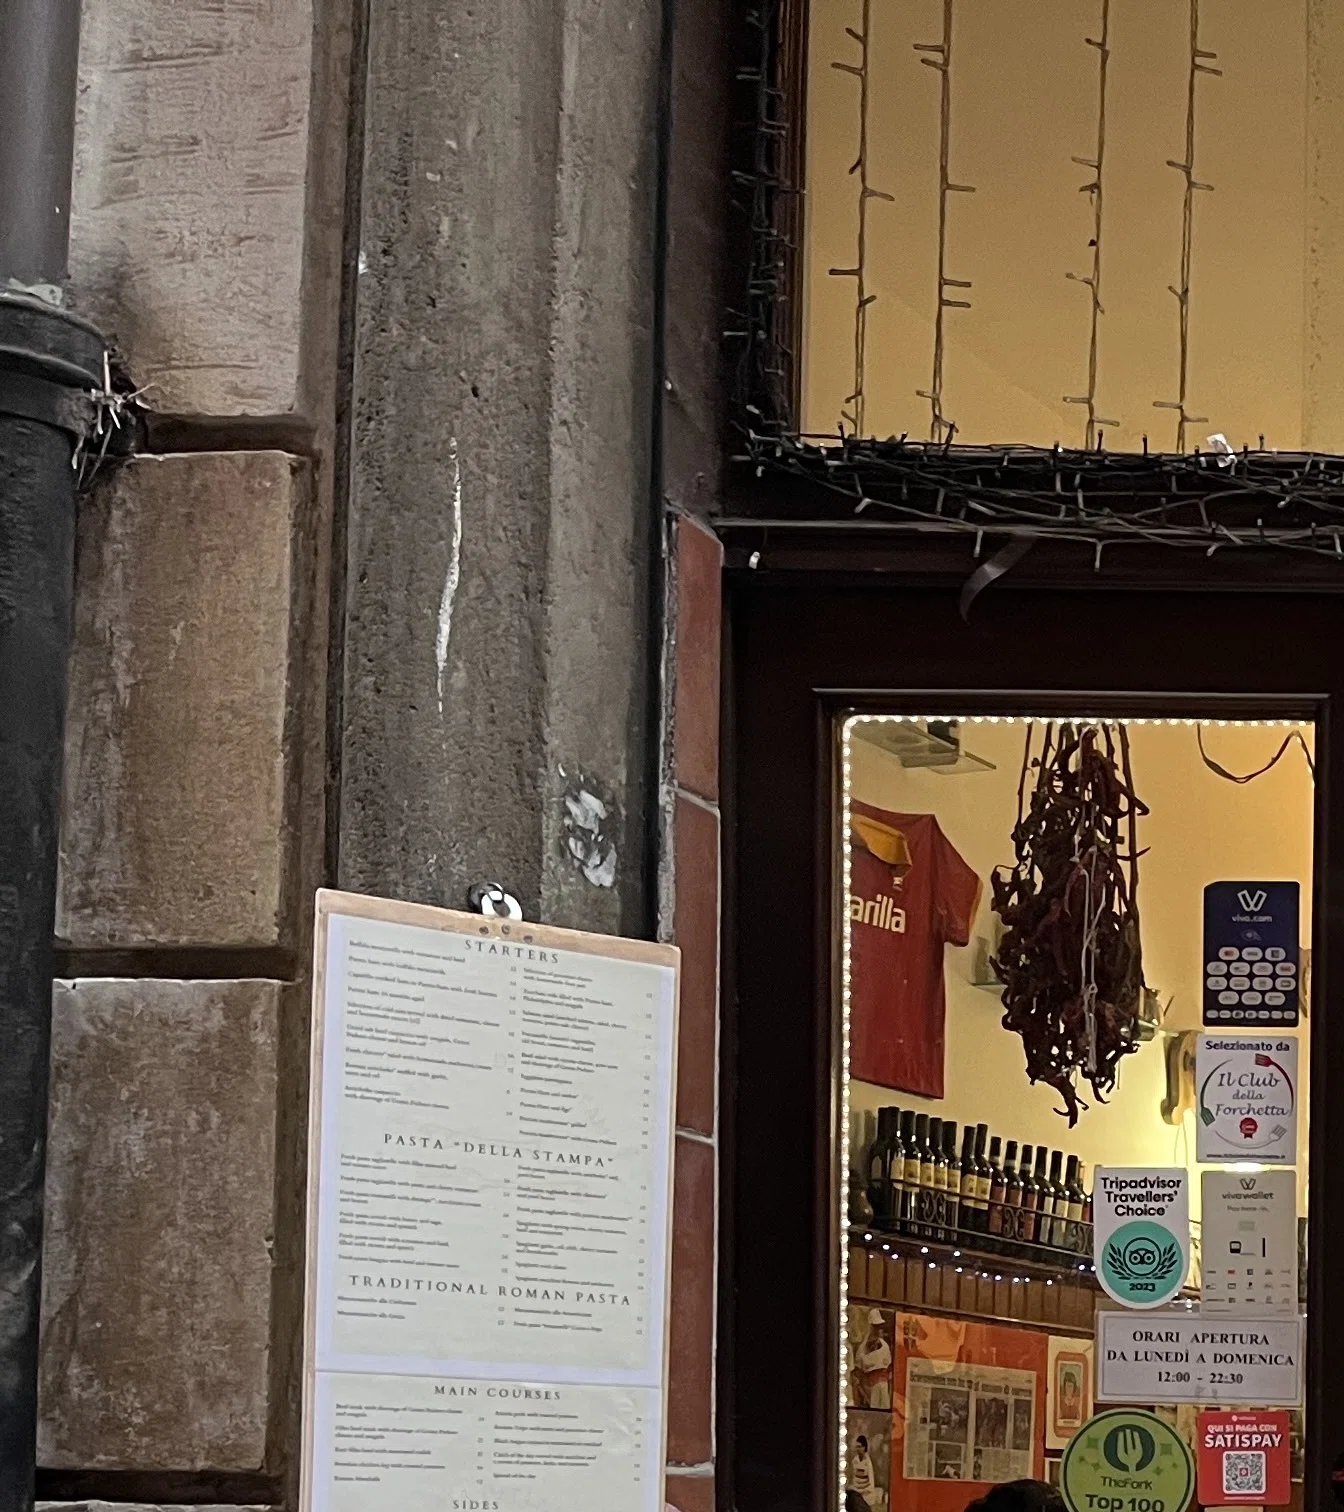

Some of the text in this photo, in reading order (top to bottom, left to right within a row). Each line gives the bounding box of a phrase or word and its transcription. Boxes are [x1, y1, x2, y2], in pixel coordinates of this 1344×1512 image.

[464, 938, 560, 966] STARTERS
[1205, 1040, 1290, 1052] Selezionato da
[1217, 1071, 1281, 1087] Il Club
[1232, 1089, 1265, 1100] della
[1215, 1102, 1289, 1117] Forchetta
[383, 1132, 444, 1151] PASTA
[1100, 1176, 1182, 1190] Tripadvisor
[1105, 1190, 1178, 1203] Travellers'
[1114, 1203, 1167, 1217] Choice
[348, 1274, 631, 1306] TRADITIONAL ROMAN PASTA
[1128, 1282, 1156, 1292] 2023
[1132, 1330, 1271, 1346] ORARI APERTURA
[1106, 1349, 1295, 1366] DA LUNEDÌ A DOMENICA
[1156, 1370, 1191, 1384] 12:00
[1208, 1372, 1244, 1385] 22:30
[434, 1385, 562, 1401] MAIN COURSES
[1207, 1424, 1224, 1433] QUI
[1225, 1424, 1234, 1432] SI
[1235, 1424, 1258, 1432] PAGA
[1204, 1433, 1283, 1448] SATISPAY
[1100, 1475, 1153, 1491] TheFork
[452, 1499, 500, 1511] SIDES
